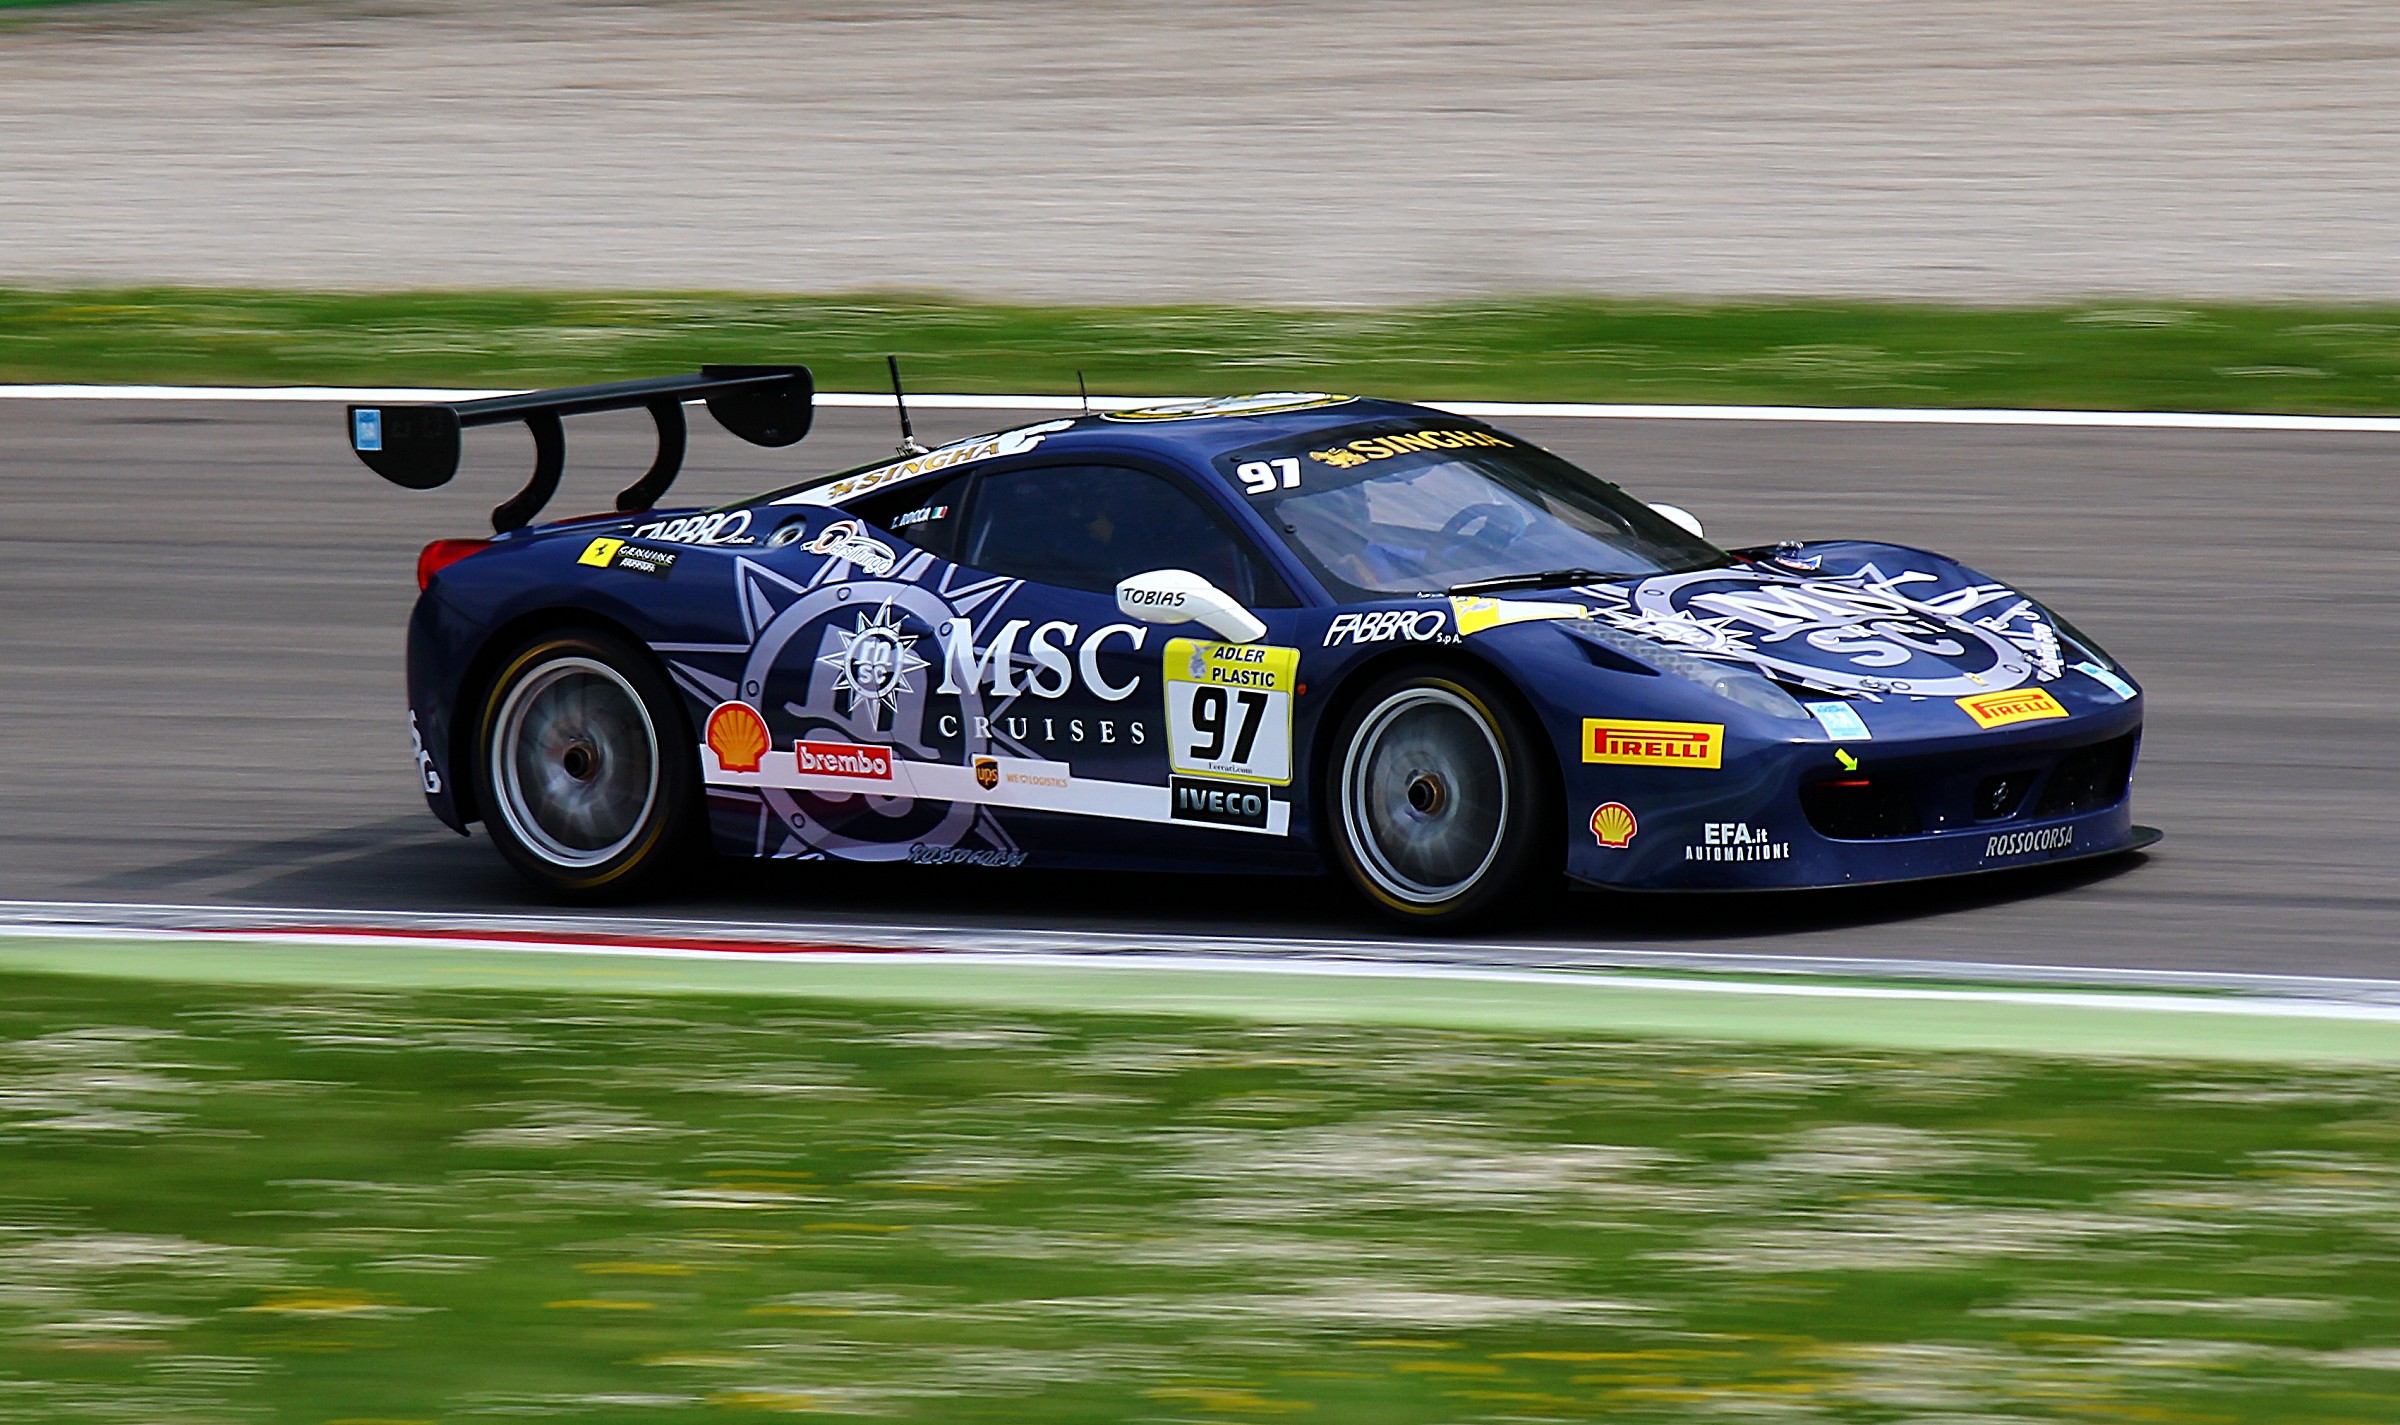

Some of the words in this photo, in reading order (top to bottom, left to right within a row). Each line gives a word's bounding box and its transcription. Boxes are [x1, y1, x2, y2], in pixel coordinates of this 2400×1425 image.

[1348, 430, 1514, 460] SINGHA
[858, 441, 999, 490] SINGHA
[1236, 456, 1302, 495] 97
[618, 545, 676, 565] GENUINE
[1123, 587, 1186, 606] TOBIAS
[1322, 610, 1446, 647] FABBRO
[936, 618, 1148, 701] MSC
[1213, 646, 1265, 663] ADLER
[1212, 667, 1275, 687] PLASTIC
[1971, 694, 2055, 719] PIRELLI
[939, 715, 1145, 745] CRUISES
[1190, 685, 1269, 765] 97
[1594, 727, 1710, 758] PIRELLI
[800, 745, 887, 775] brembo
[976, 766, 999, 787] ups
[1028, 774, 1068, 788] LOGISTICS
[1179, 787, 1262, 817] IVECO
[1704, 822, 1768, 844] EFA.it
[1985, 825, 2073, 857] ROSSOCORSA
[1685, 843, 1789, 861] AUTOMAZIONE
